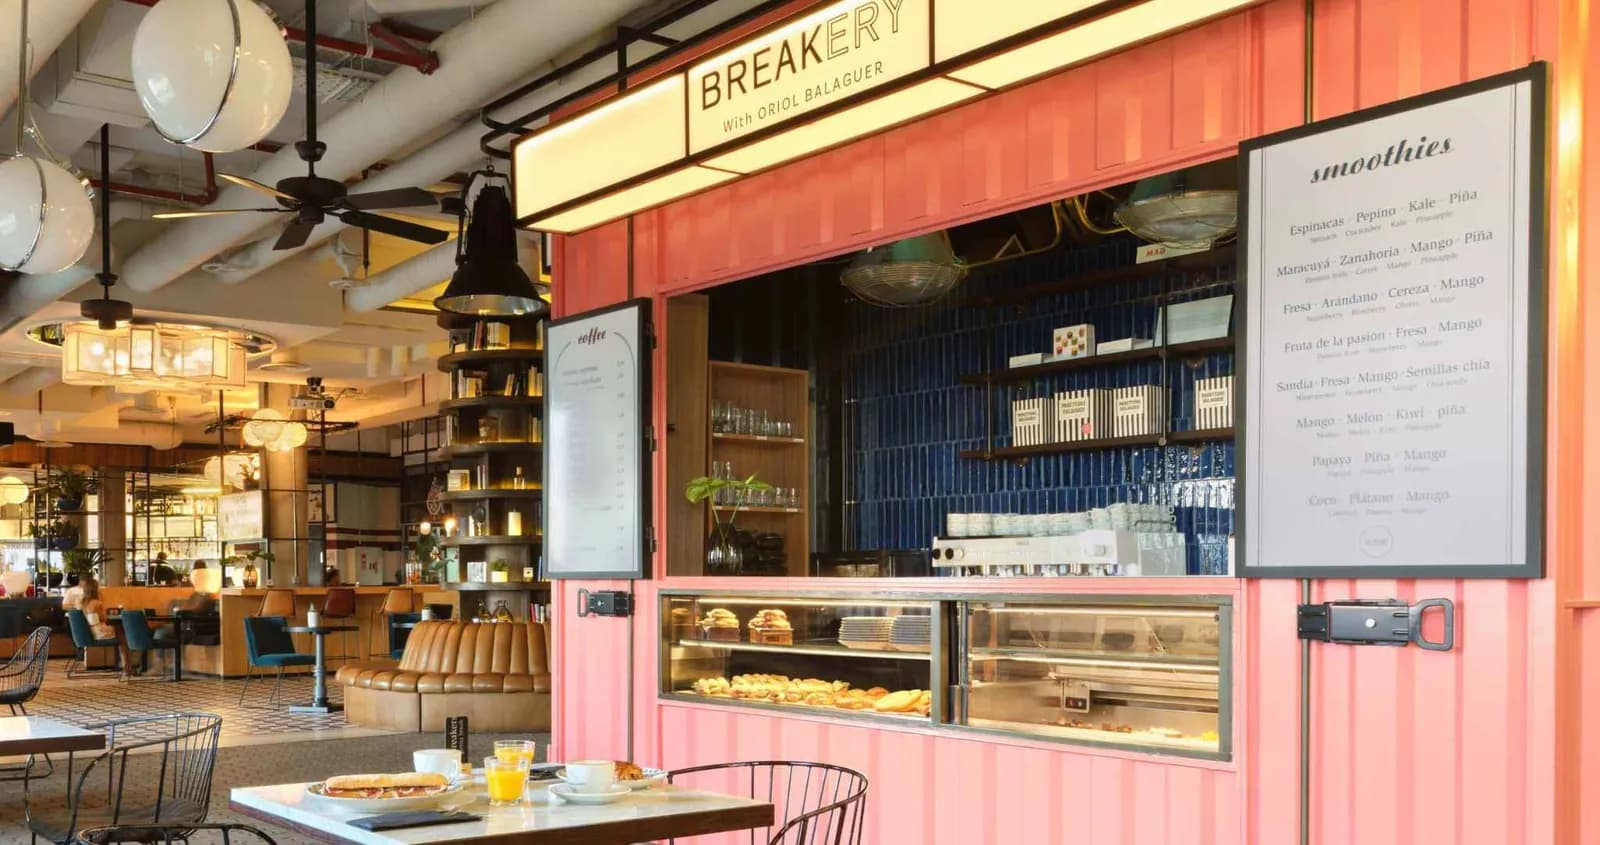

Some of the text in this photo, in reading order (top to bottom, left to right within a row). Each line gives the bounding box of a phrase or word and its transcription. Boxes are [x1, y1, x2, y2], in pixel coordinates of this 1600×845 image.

[702, 0, 904, 110] BREAKERY
[723, 61, 885, 134] With ORIOL BALAGUER
[1310, 136, 1454, 184] smoothies
[1290, 189, 1478, 237] Espinacas Pepino Kale Piña
[1276, 230, 1494, 278] Maracuyá Zanahoria Mango Piña
[1283, 274, 1485, 315] Fresa Arándano Cereza Mango
[577, 326, 607, 345] coffee
[1284, 317, 1483, 353] Fruta de la pasión Fresa Mango
[1320, 376, 1350, 389] Fresa
[1357, 369, 1400, 385] Mango
[1405, 361, 1459, 378] Semillas
[1296, 416, 1335, 430] Mango
[1396, 407, 1425, 421] Kiwi
[1312, 455, 1352, 469] Papaya
[1403, 448, 1448, 463] Mango
[1309, 495, 1337, 507] Coco
[1406, 489, 1450, 505] Mango
